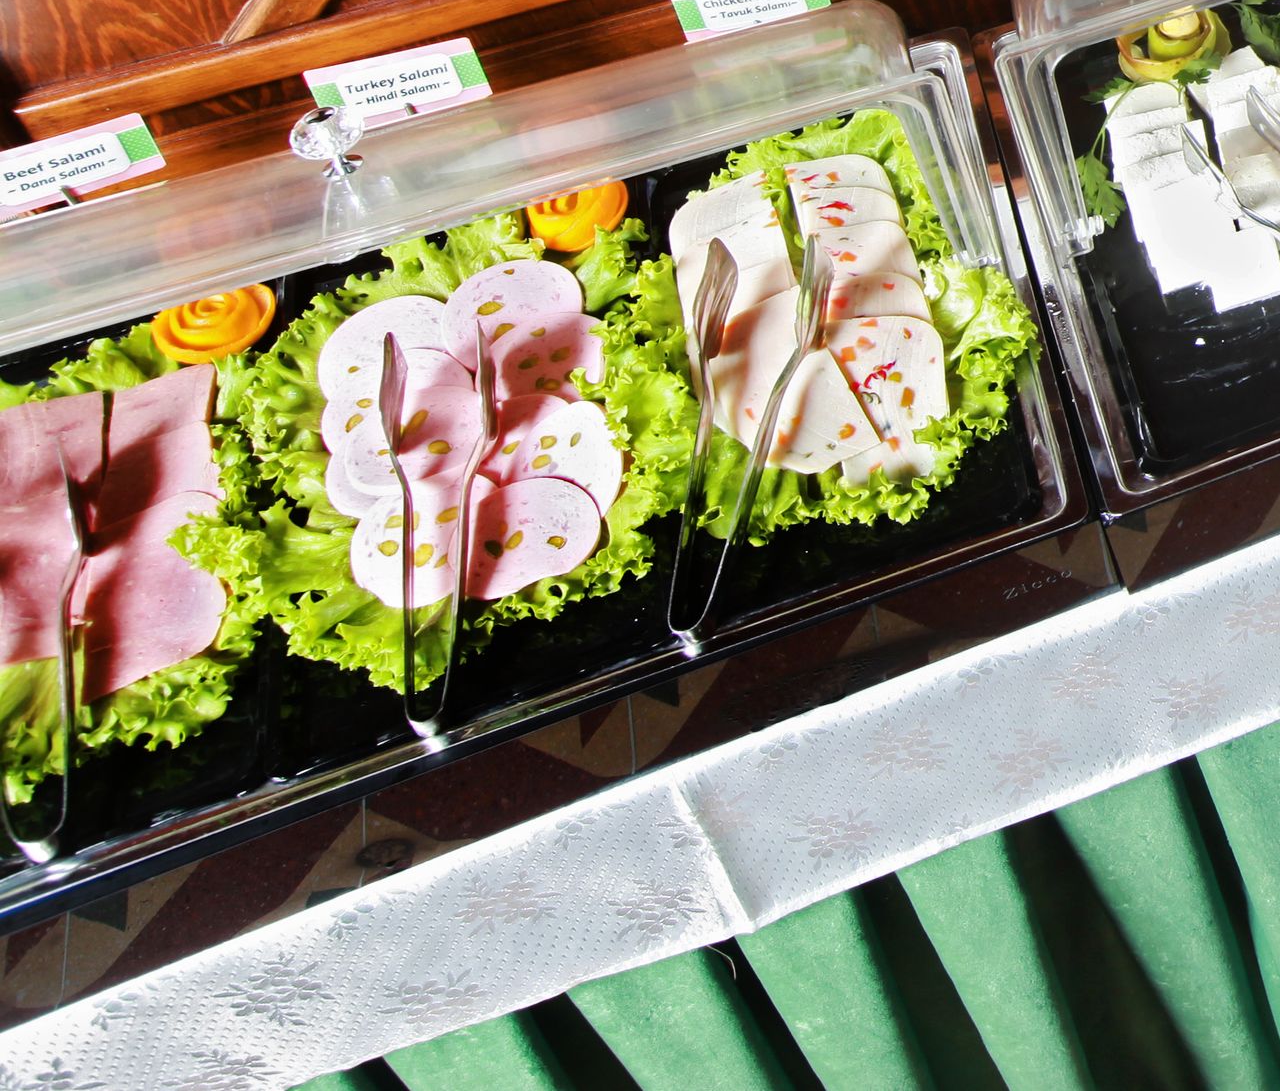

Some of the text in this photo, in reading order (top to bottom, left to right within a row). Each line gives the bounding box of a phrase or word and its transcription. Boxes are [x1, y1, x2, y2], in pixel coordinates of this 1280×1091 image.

[721, 8, 753, 19] Tavuk
[345, 63, 448, 95] Turkey Salami
[366, 82, 440, 105] Hindi Salamı
[3, 144, 107, 182] Beef Salami
[20, 160, 105, 192] Dana Salamı
